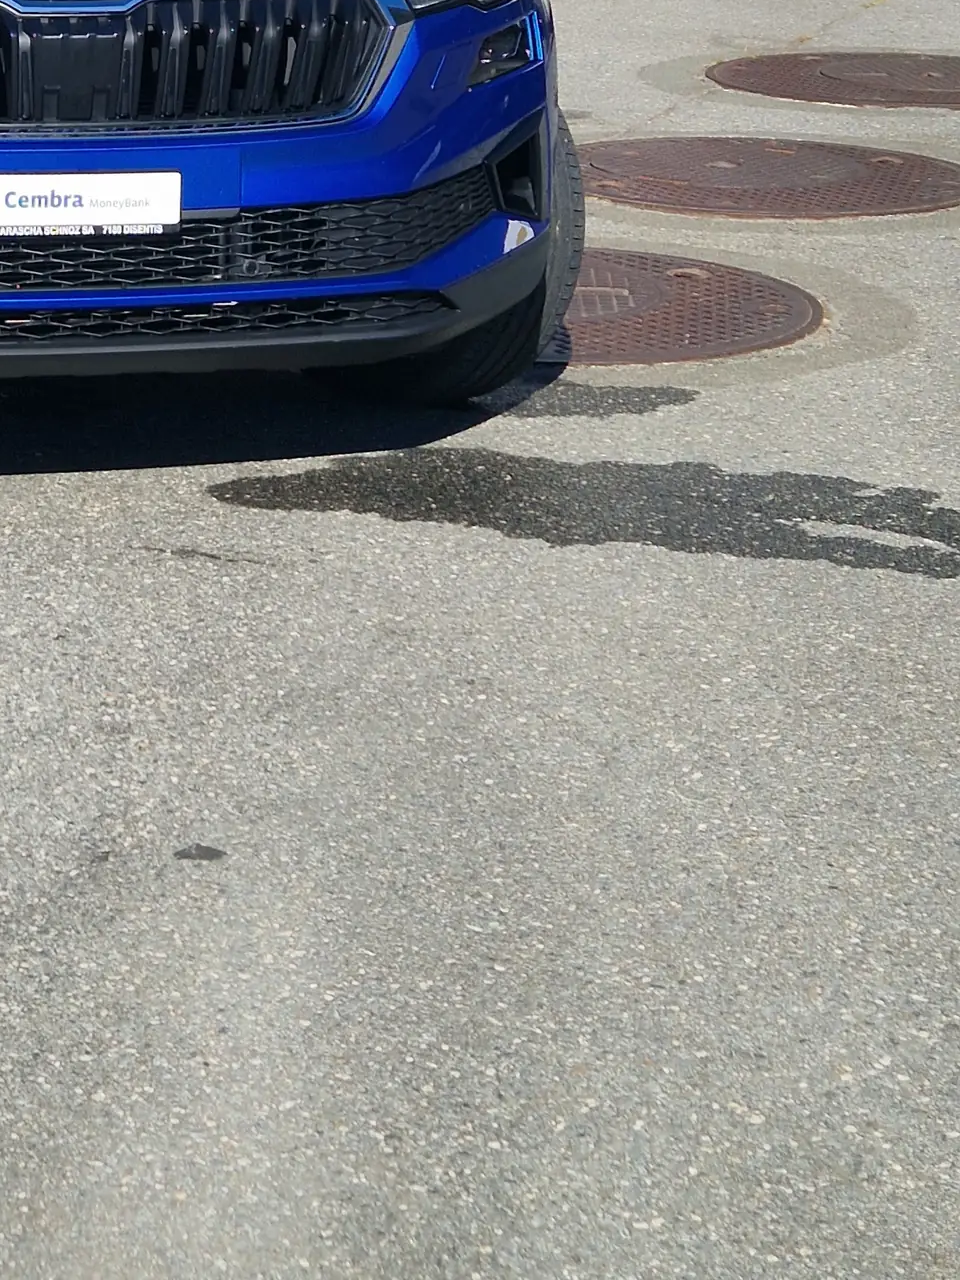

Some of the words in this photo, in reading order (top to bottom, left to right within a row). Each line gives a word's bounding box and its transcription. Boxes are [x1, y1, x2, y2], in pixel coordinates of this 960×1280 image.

[4, 189, 84, 208] Cembra
[89, 197, 152, 210] MoneyBank
[43, 225, 81, 236] SCHNOZ
[81, 225, 95, 235] SA
[123, 224, 164, 234] DISENTIS
